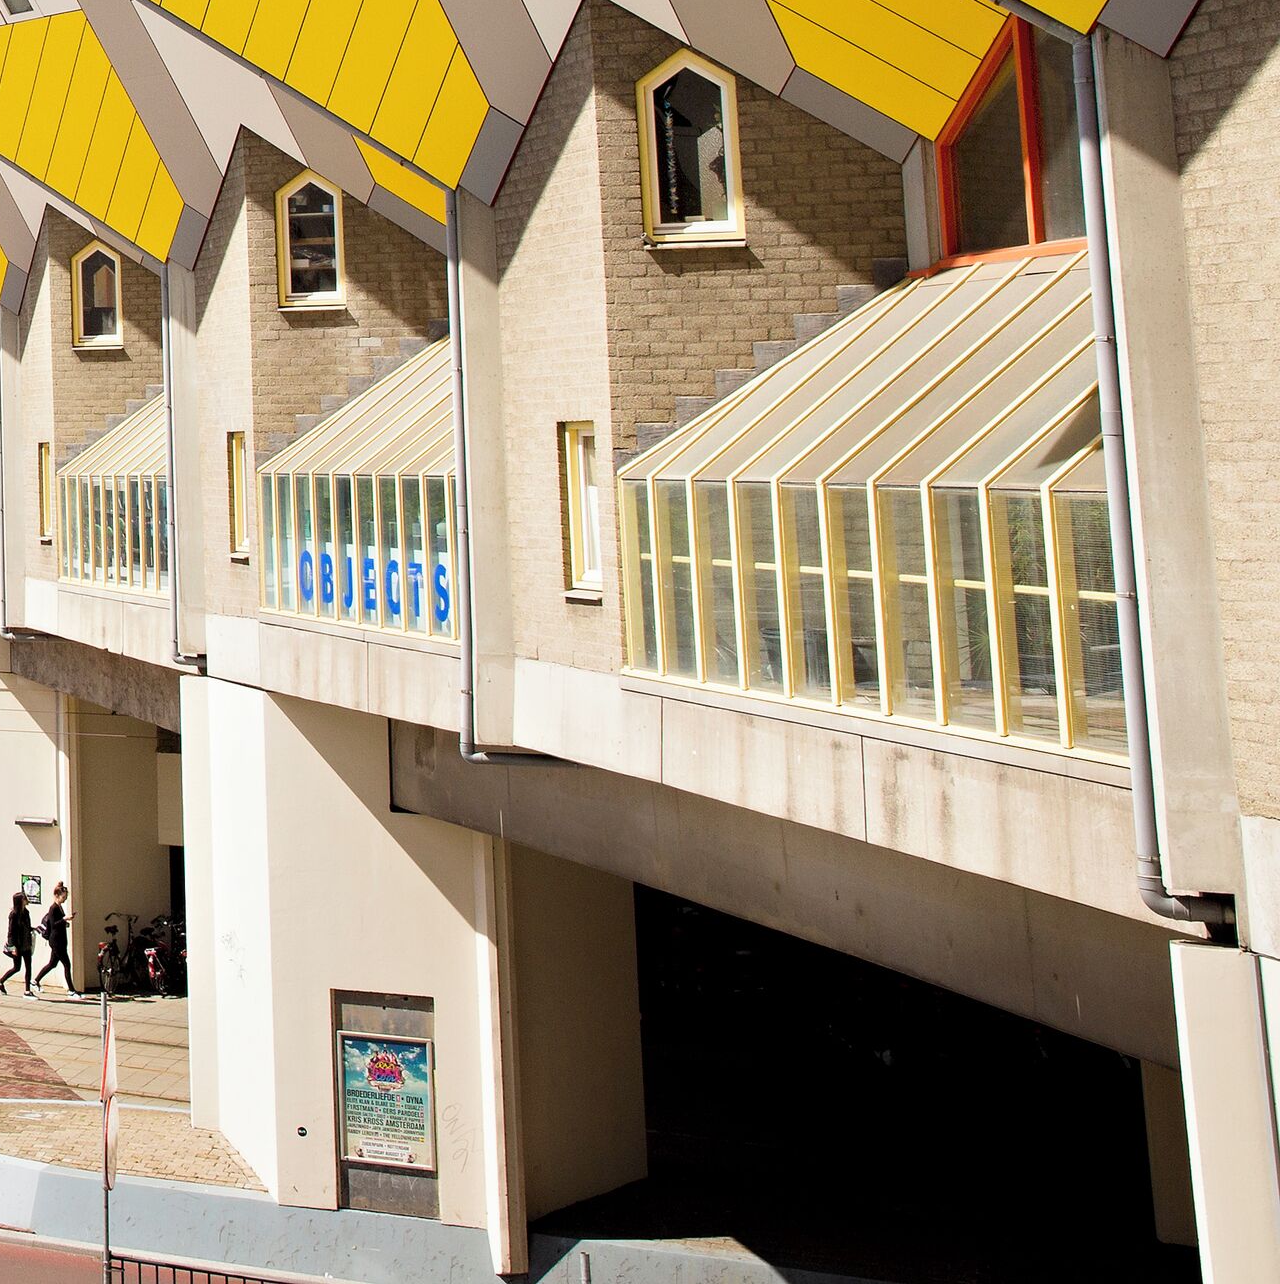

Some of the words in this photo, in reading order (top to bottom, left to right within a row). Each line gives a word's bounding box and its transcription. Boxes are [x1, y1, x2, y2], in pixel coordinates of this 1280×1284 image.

[299, 549, 450, 622] OBJECTS
[346, 1089, 396, 1102] BROEDERLIEFDE
[398, 1109, 420, 1117] PARDOEL
[363, 1117, 384, 1126] KROSS
[386, 1119, 425, 1130] AMSTERDAM
